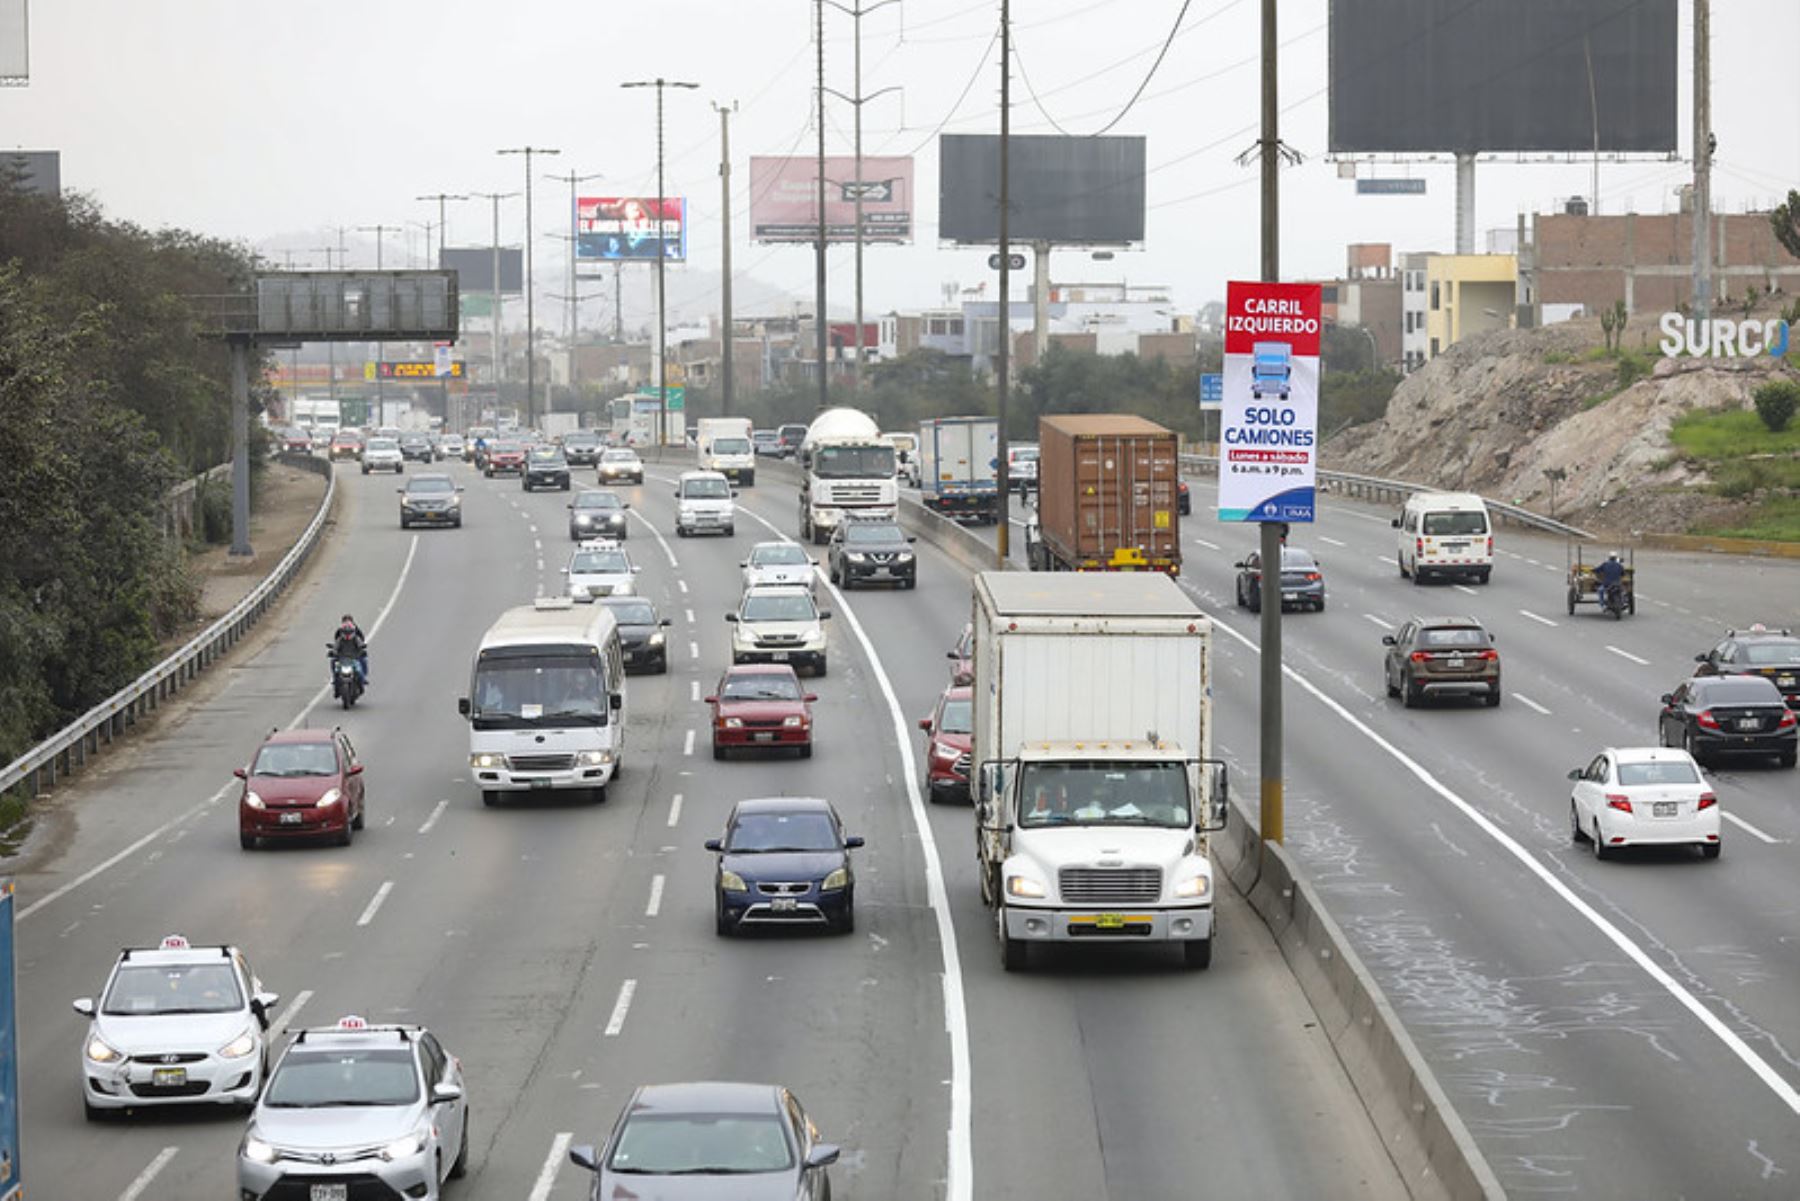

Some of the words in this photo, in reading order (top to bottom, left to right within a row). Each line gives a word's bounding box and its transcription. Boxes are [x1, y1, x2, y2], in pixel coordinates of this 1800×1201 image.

[1244, 298, 1303, 315] CARRIL
[1228, 316, 1319, 334] IZQUIERDO
[1659, 312, 1790, 358] SURCO
[1245, 407, 1296, 426] SOLO
[1224, 427, 1314, 447] CAMIONES
[1231, 464, 1239, 473] 6
[1265, 466, 1271, 474] a
[1272, 465, 1279, 474] 9
